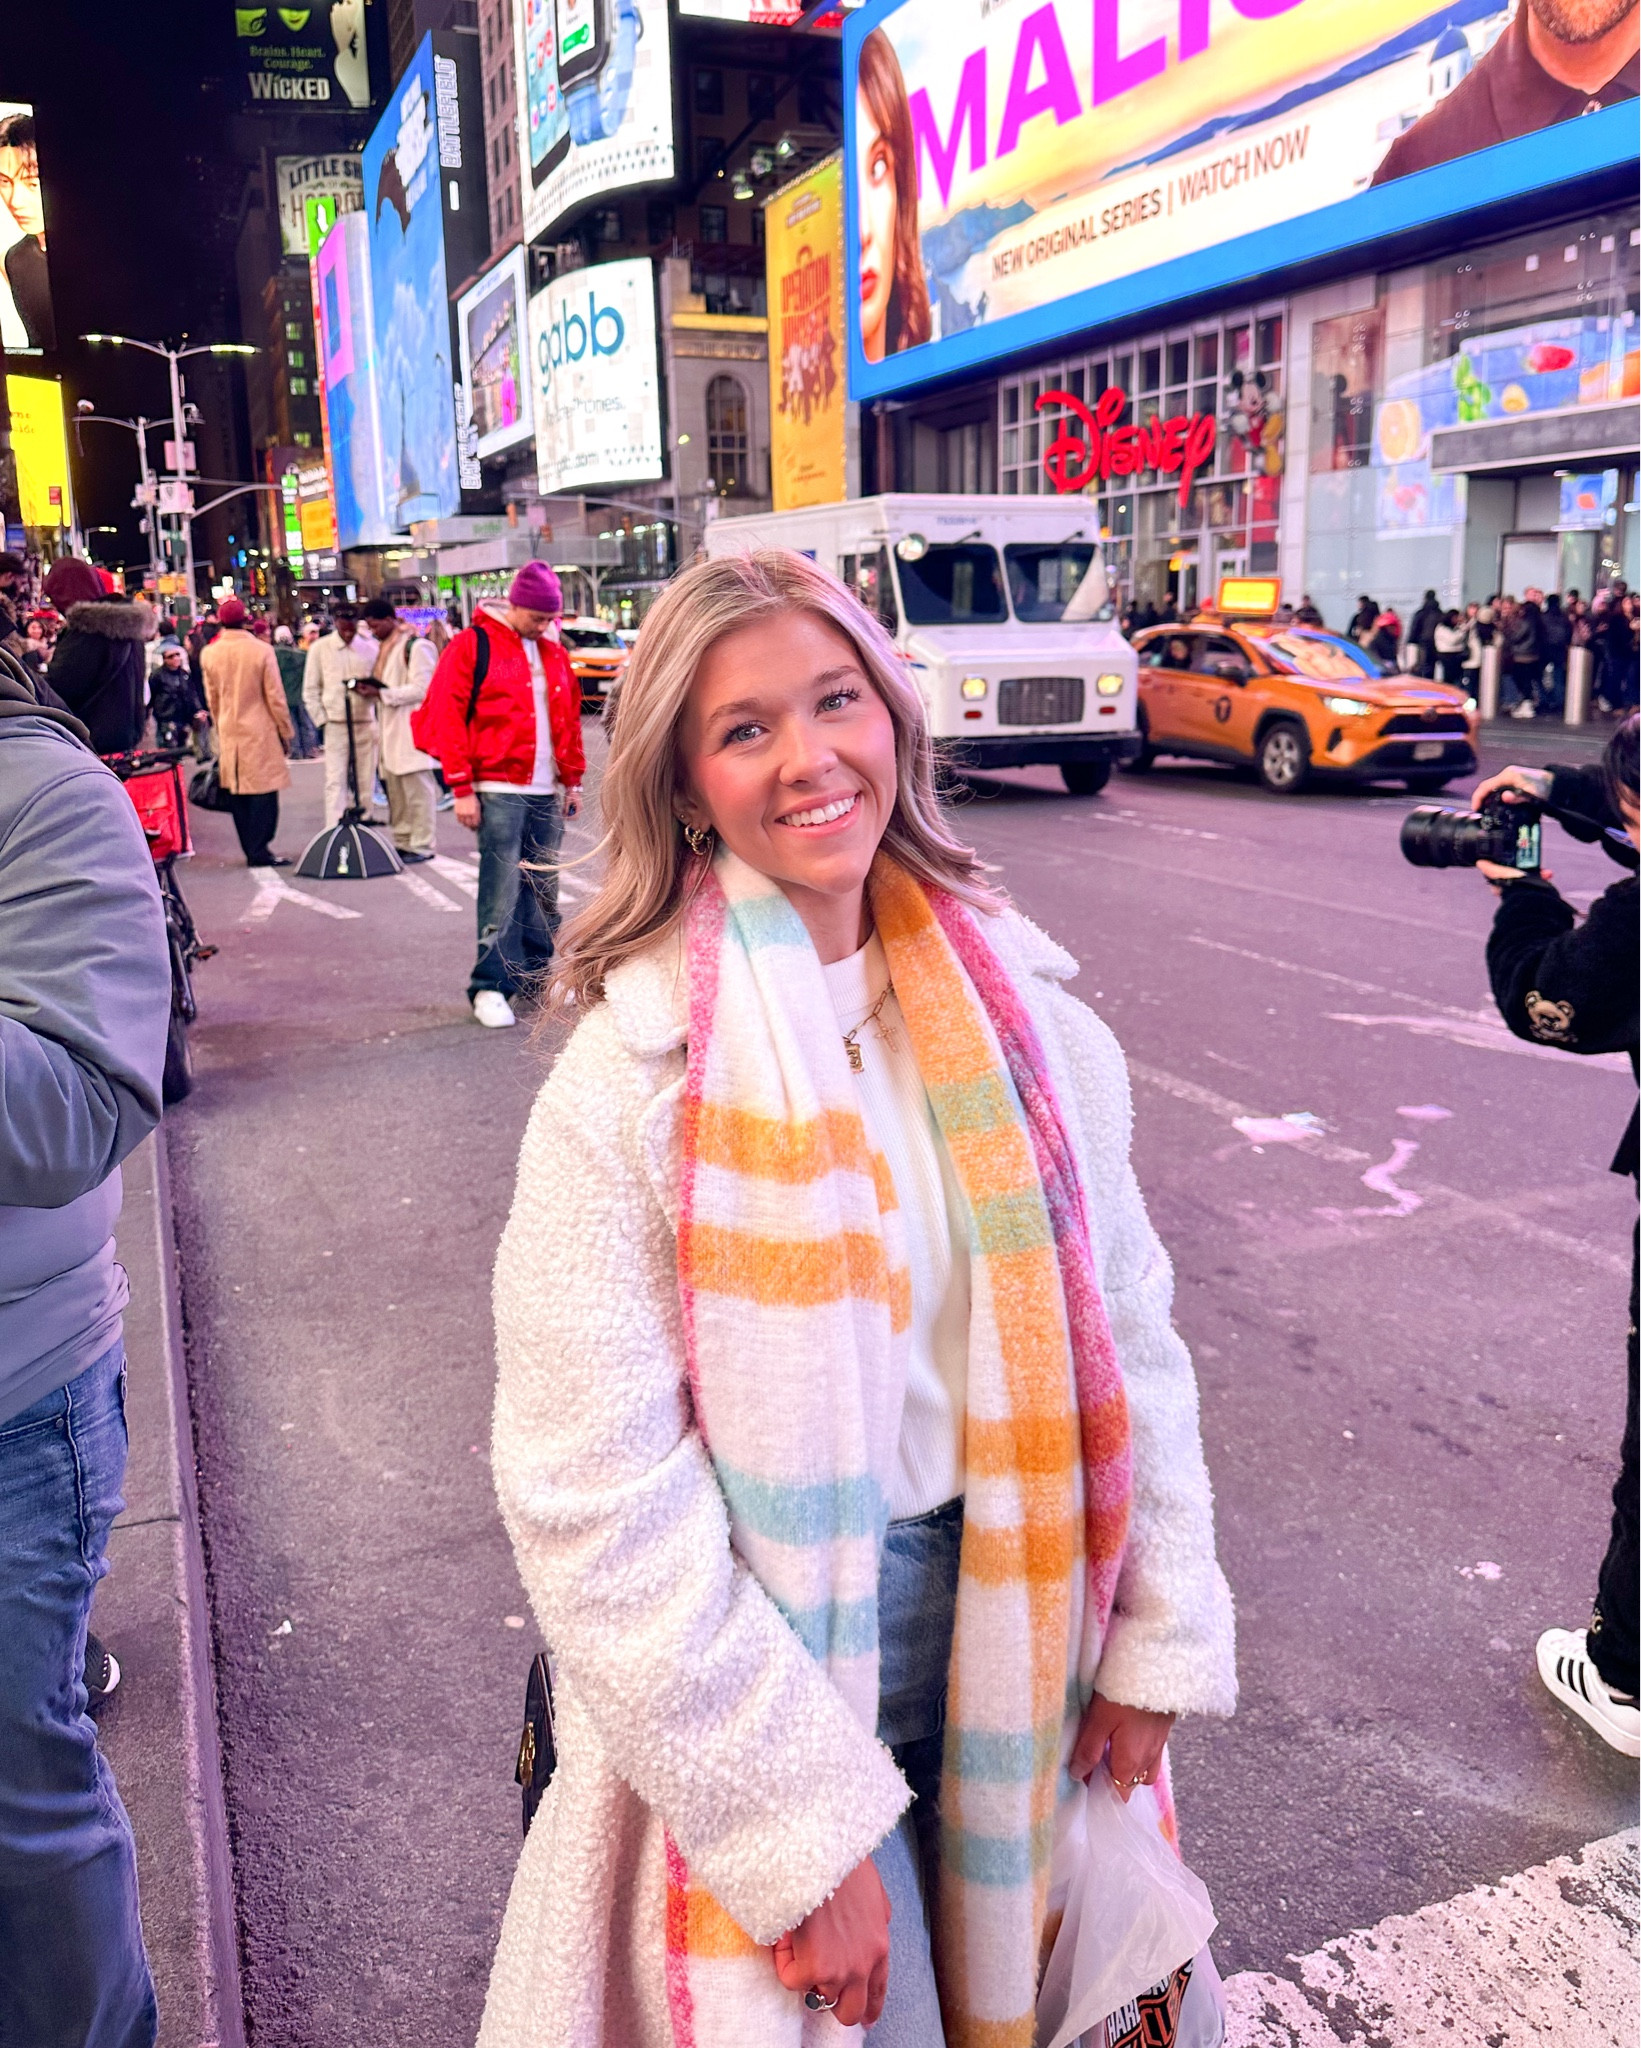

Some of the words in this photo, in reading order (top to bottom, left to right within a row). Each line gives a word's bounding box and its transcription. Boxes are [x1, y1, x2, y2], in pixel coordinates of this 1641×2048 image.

[289, 158, 340, 189] LITTLE
[991, 244, 1023, 281] NEW
[1025, 215, 1099, 268] ORIGINAL
[1101, 188, 1164, 237] SERIES
[1178, 152, 1251, 206] WATCH
[1253, 124, 1311, 179] NOW
[538, 290, 625, 395] gabb
